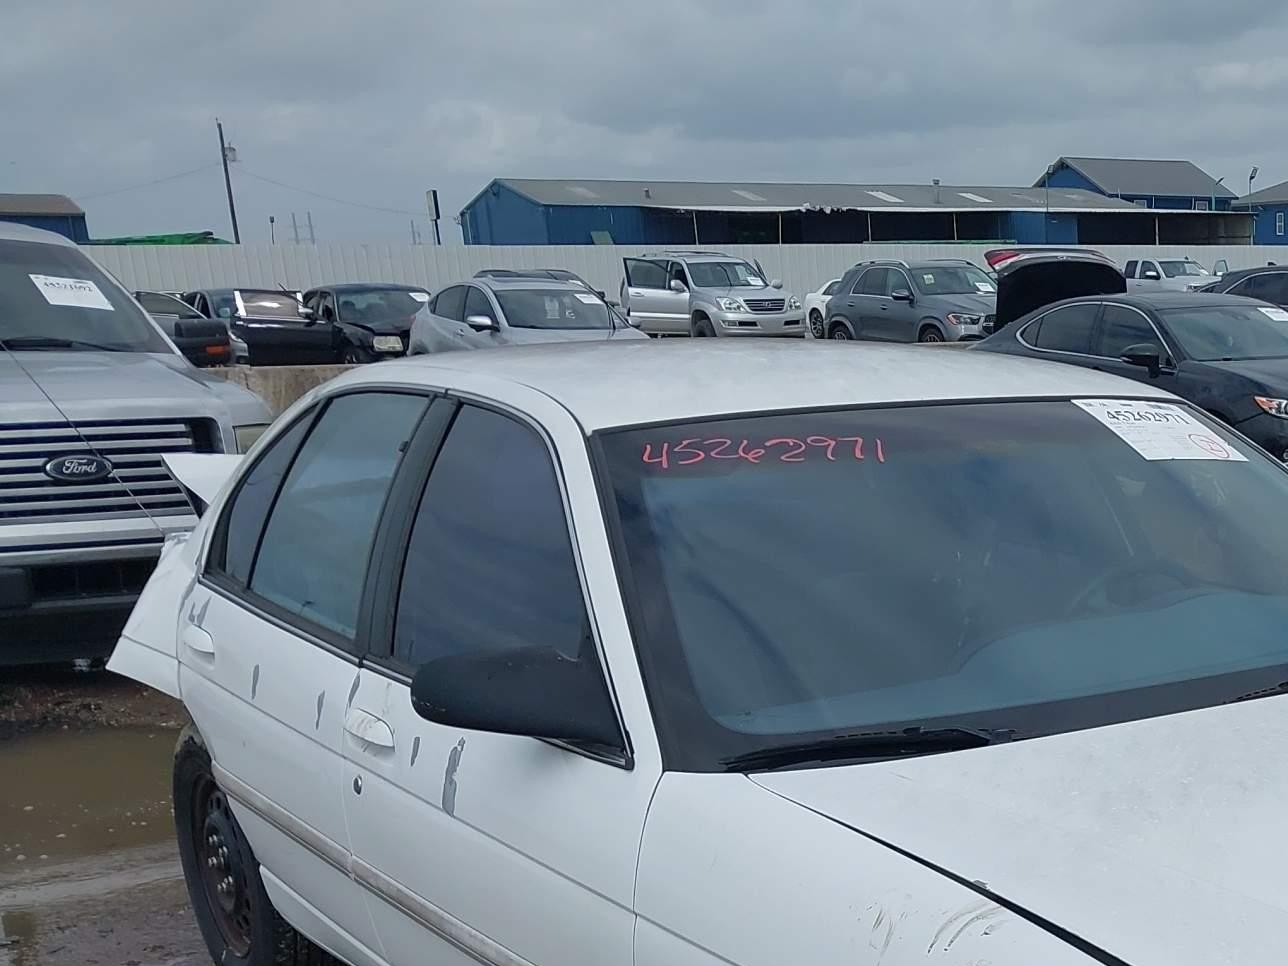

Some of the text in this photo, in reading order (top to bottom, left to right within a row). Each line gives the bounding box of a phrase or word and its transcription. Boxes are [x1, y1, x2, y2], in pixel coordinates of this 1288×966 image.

[1106, 410, 1190, 425] 45262971
[643, 436, 886, 469] 45262971
[62, 459, 97, 474] Ford
